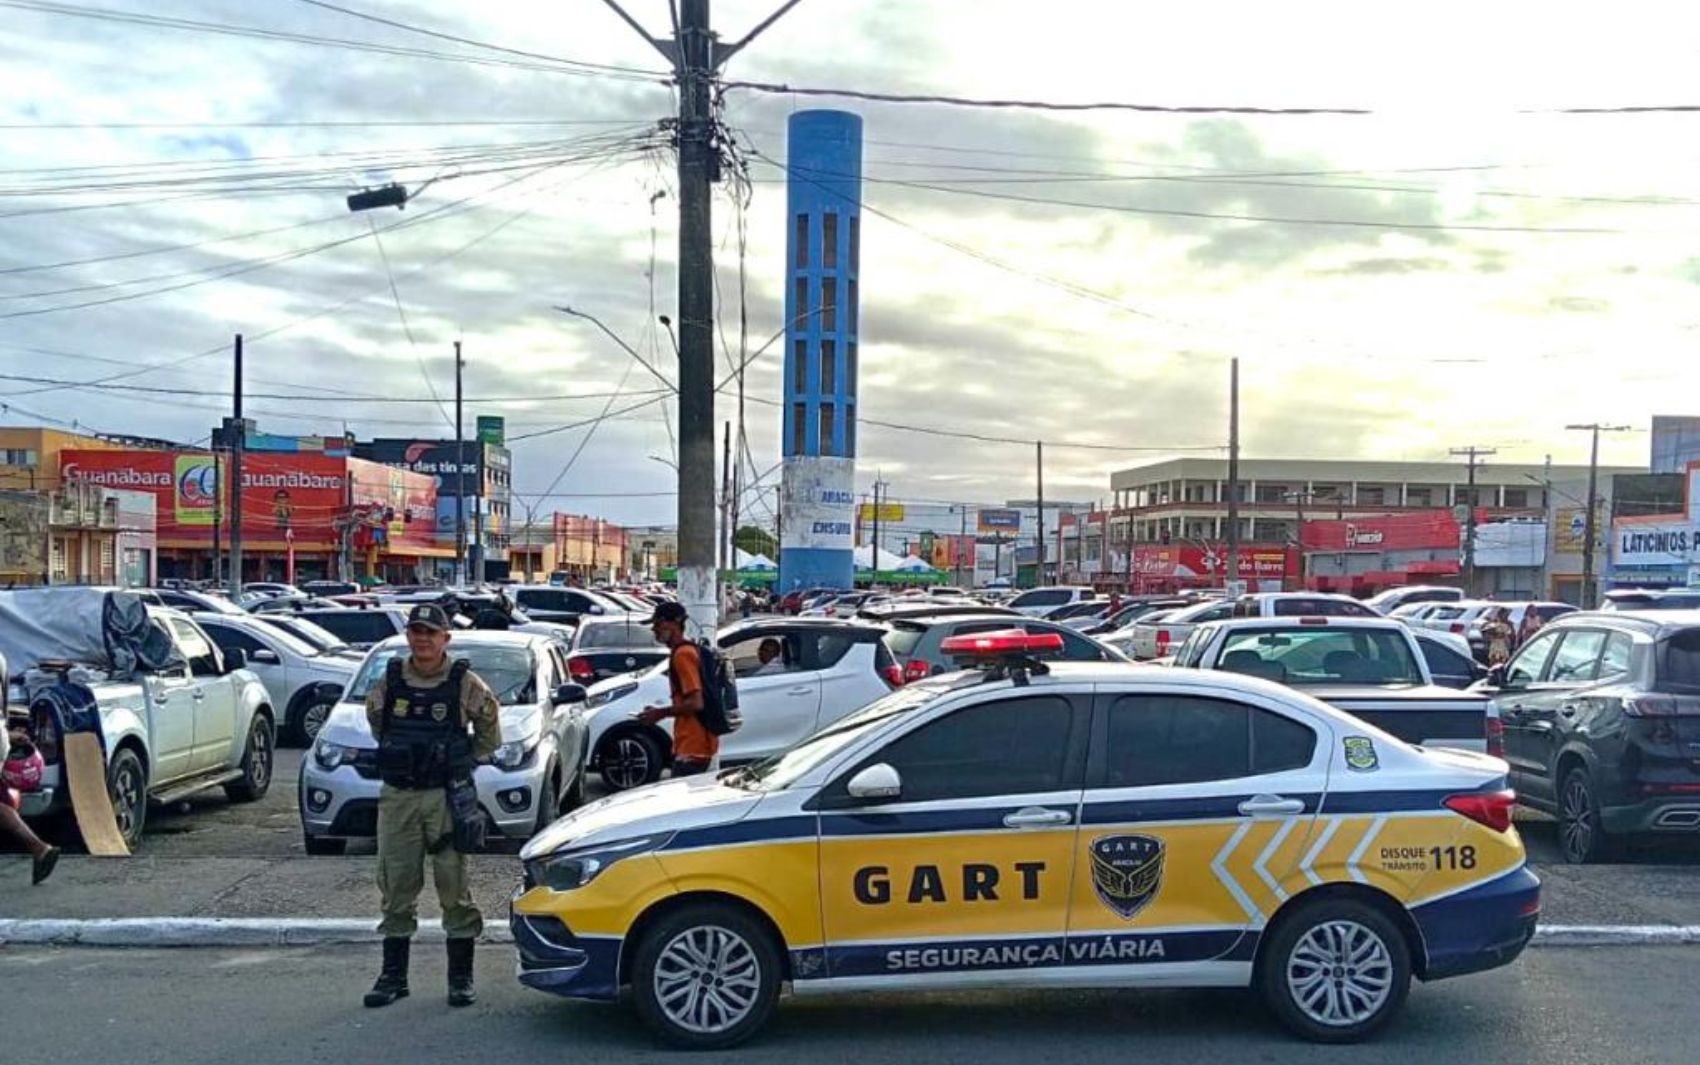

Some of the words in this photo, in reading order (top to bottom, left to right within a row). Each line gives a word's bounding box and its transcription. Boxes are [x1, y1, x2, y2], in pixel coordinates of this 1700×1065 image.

[63, 463, 171, 485] Guanabara
[439, 461, 477, 474] tinas
[1101, 842, 1152, 852] GART
[1380, 848, 1426, 859] DISQUE
[1430, 845, 1476, 870] 118
[853, 862, 1046, 905] GART
[886, 944, 1060, 970] SEGURANÇA
[1069, 936, 1166, 960] VIÁRIA
